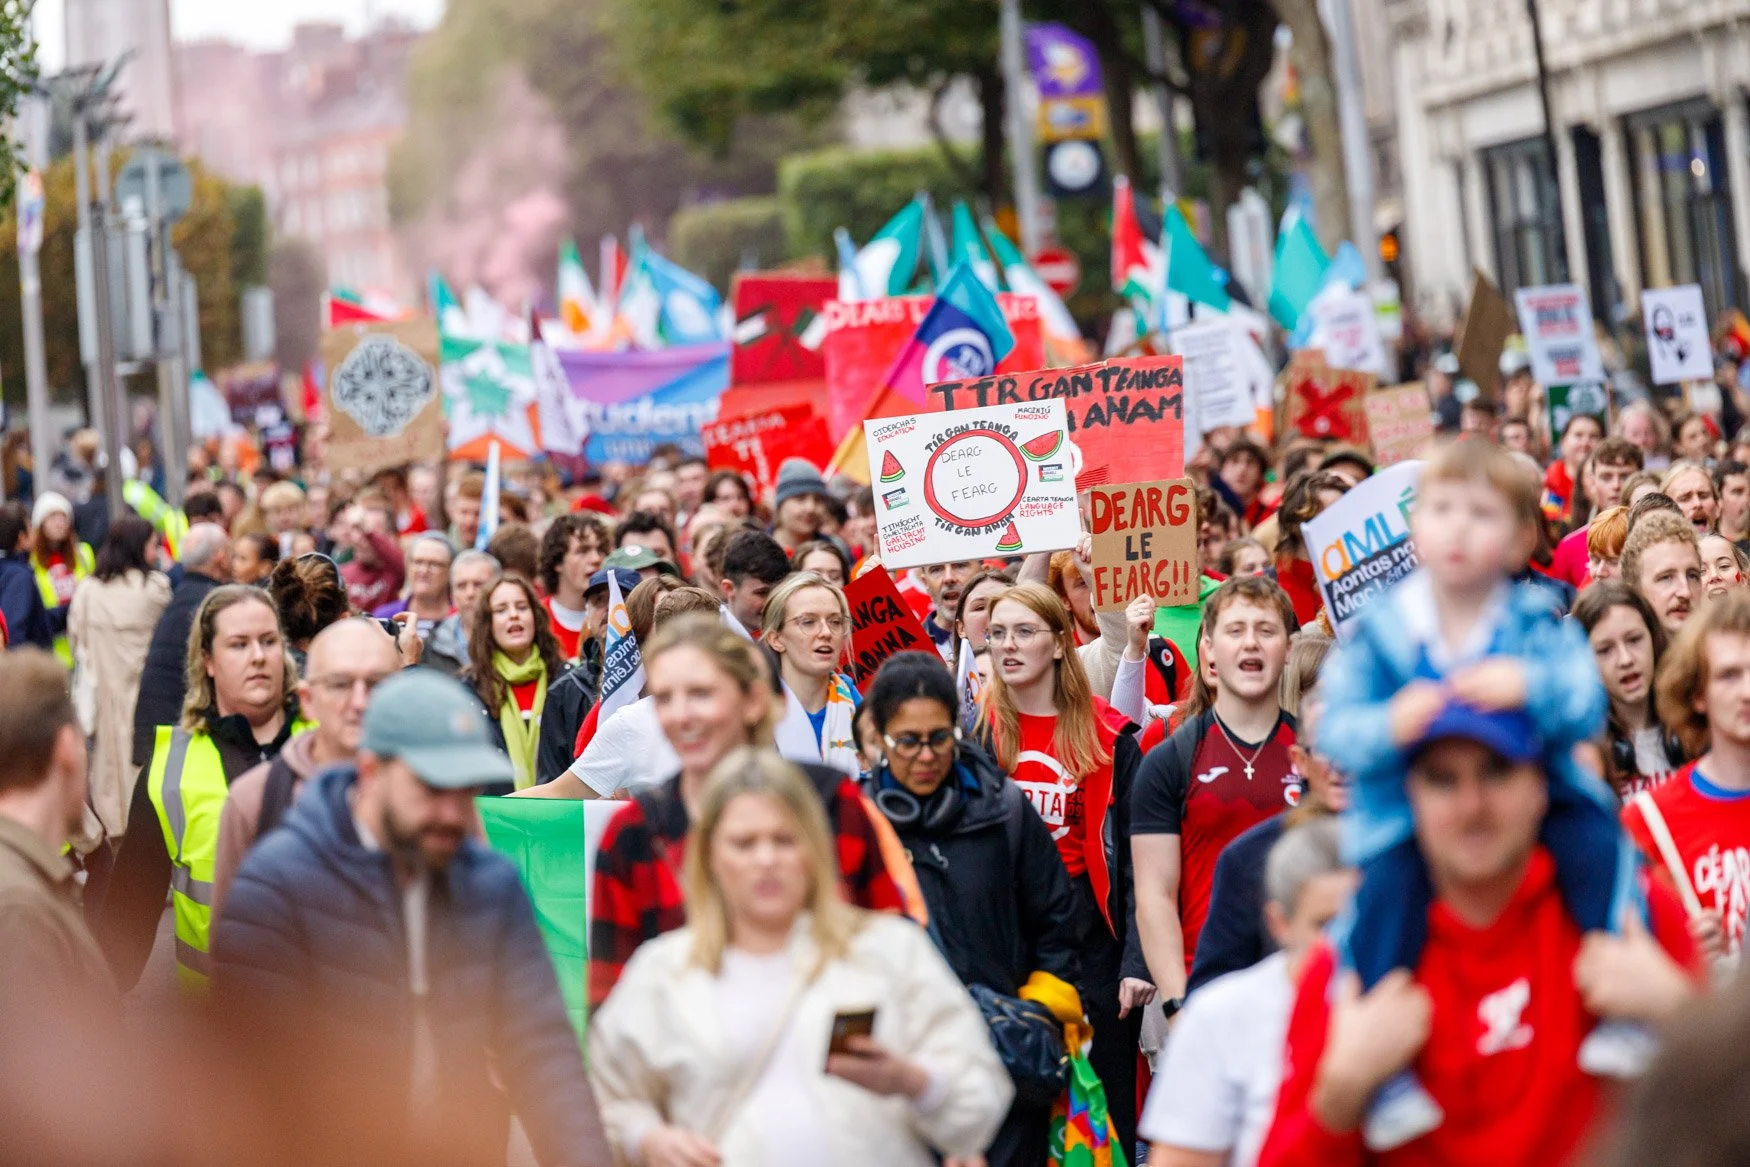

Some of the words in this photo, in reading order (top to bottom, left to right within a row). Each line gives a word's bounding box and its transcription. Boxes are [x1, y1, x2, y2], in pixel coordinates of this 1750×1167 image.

[1028, 373, 1092, 401] GAN
[1095, 365, 1183, 392] TEANGA
[1082, 393, 1182, 430] ANAM
[873, 417, 917, 437] OIDEACHAS
[877, 425, 915, 443] EDUCATION
[925, 433, 946, 453] TÍR
[945, 423, 970, 438] GAN
[972, 420, 1018, 441] TEANGA
[940, 446, 982, 463] DEARG
[957, 465, 972, 477] LE
[951, 482, 998, 501] FEARG
[1020, 509, 1053, 517] RIGHTS
[1091, 485, 1189, 534] DEARG
[885, 526, 926, 547] GAELTACHT
[954, 526, 980, 537] GAN
[887, 535, 926, 554] HOUSING
[1126, 532, 1152, 561] LE
[1094, 559, 1189, 606] FEARG!!
[1332, 554, 1392, 599] Aontas
[852, 594, 905, 633] ANGA
